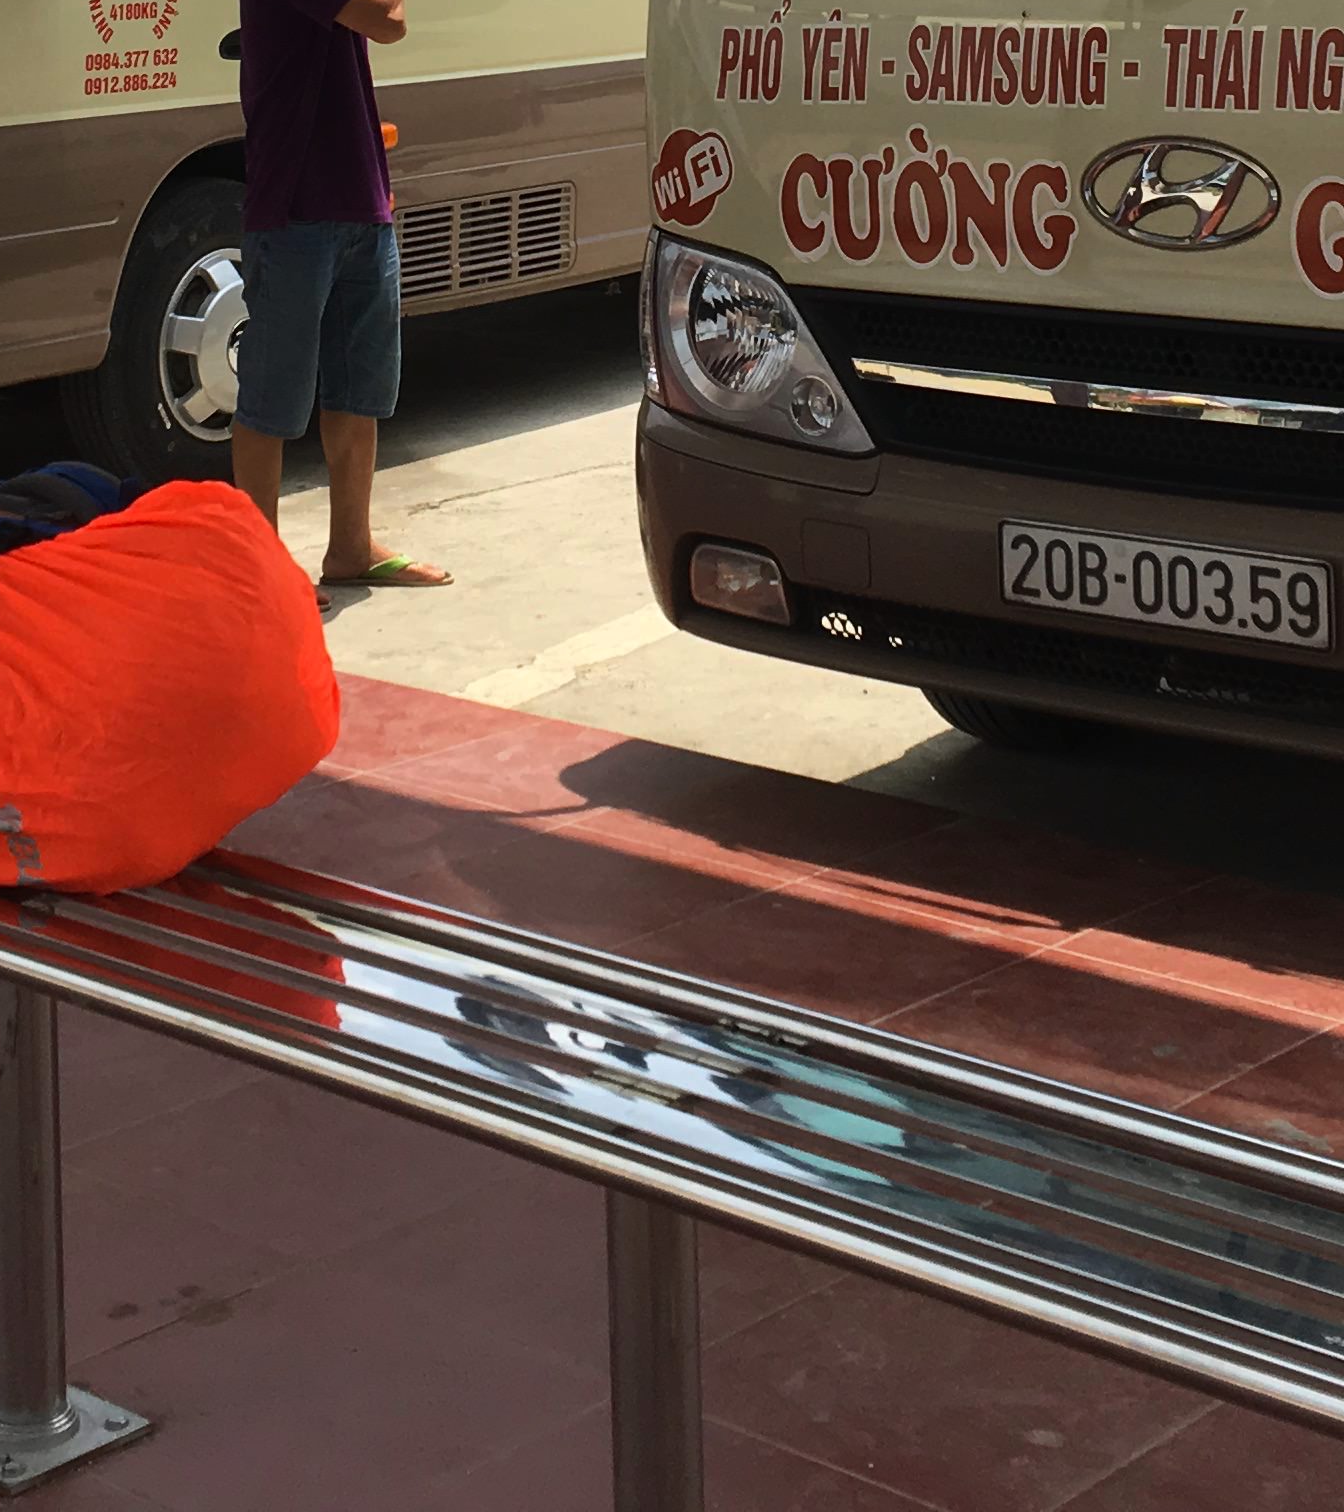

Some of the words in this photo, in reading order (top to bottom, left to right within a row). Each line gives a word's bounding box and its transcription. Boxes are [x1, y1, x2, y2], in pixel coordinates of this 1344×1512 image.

[110, 1, 158, 21] 4180KG
[84, 71, 177, 96] 0912.886.224
[85, 50, 149, 72] 0984.377
[153, 48, 178, 67] 632
[801, 9, 869, 103] YÊN
[905, 21, 1109, 108] SAMSUNG
[1163, 9, 1265, 112] THÁI
[782, 124, 1079, 275] CƯỜNG
[1010, 533, 1321, 639] 20B-003.59
